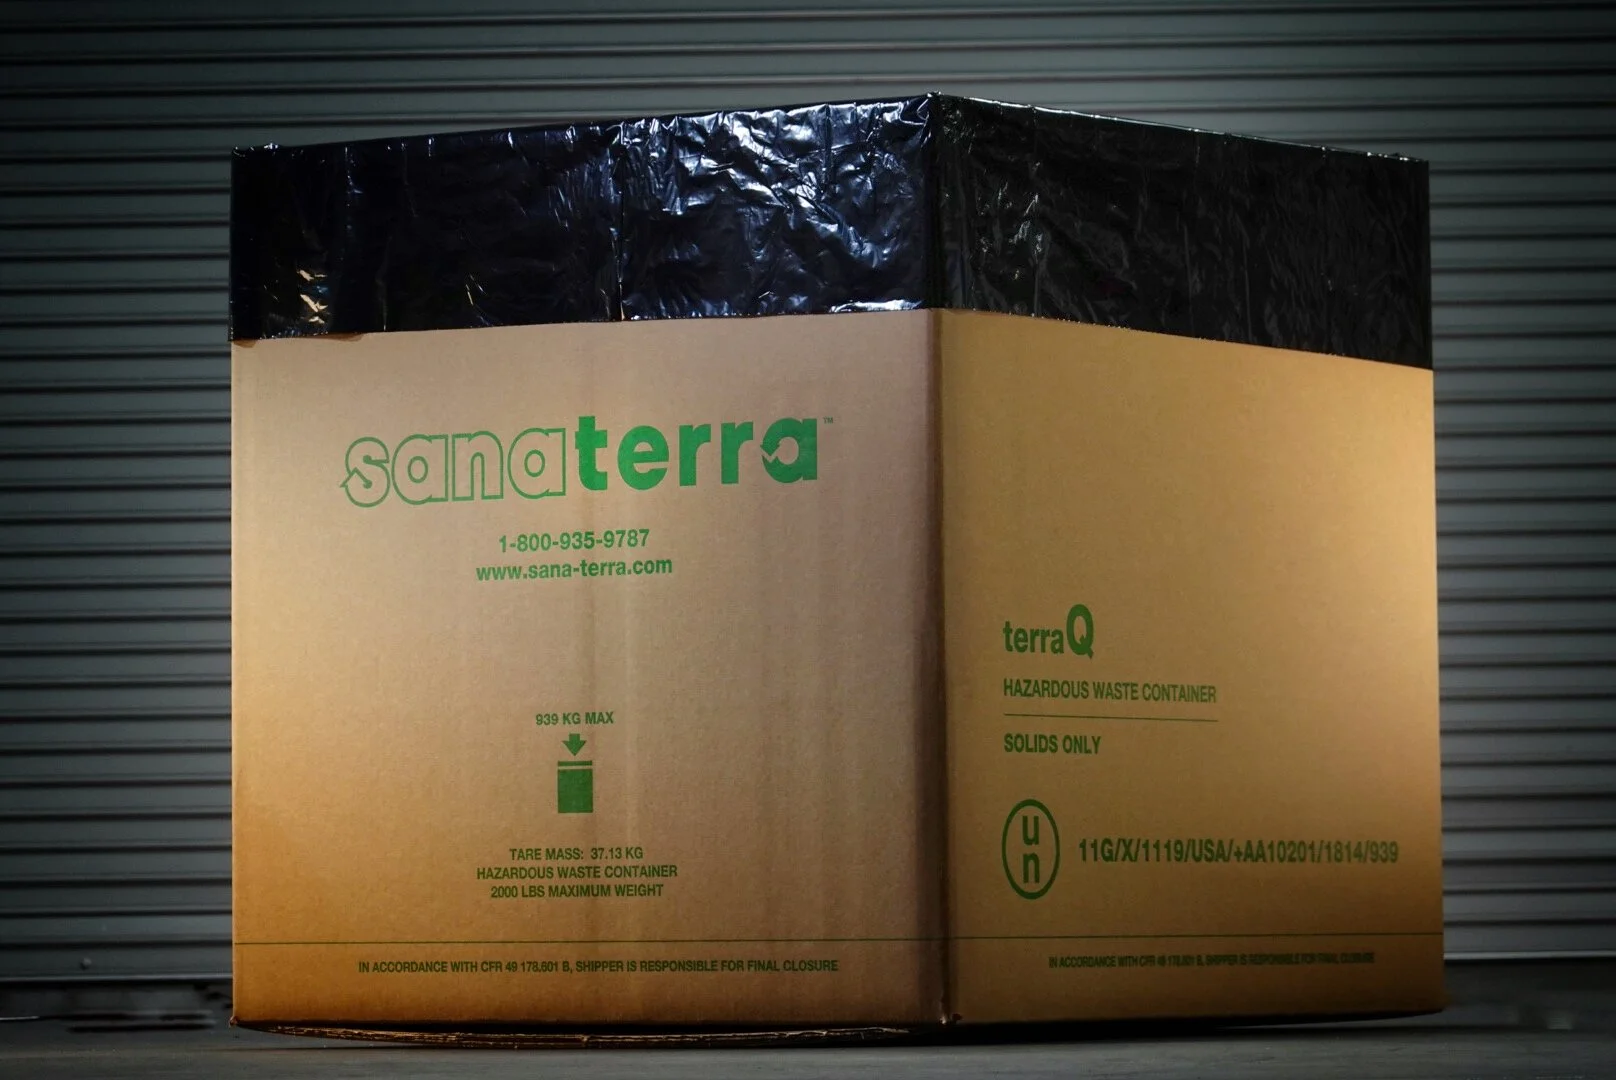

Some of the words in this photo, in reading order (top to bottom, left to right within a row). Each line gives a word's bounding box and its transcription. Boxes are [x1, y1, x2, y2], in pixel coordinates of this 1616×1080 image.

[499, 528, 650, 554] 1-800-935-9787
[476, 558, 673, 581] www.sana-terra.com
[1003, 677, 1089, 699] HAZARDOUS
[1092, 680, 1139, 701] WASTE
[1142, 683, 1217, 703] CONTAINER
[535, 713, 559, 726] 939
[562, 712, 581, 725] KG
[585, 711, 614, 724] MAX
[1003, 733, 1059, 753] SOLIDS
[1062, 735, 1101, 754] ONLY
[509, 848, 542, 860] TARE
[545, 847, 584, 860] MASS:
[590, 847, 622, 860] 37.13
[625, 846, 644, 859] KG
[1079, 837, 1399, 864] 11G/X/1119/USA/+AA10201/1814/939
[476, 866, 554, 880] HAZARDOUS
[557, 865, 601, 879] WASTE
[604, 864, 678, 878] CONTAINER
[490, 885, 518, 898] 2000
[521, 884, 545, 898] LBS
[548, 884, 611, 897] MAXIMUM
[614, 883, 664, 897] WEIGHT
[358, 961, 370, 973] IN
[372, 961, 448, 973] ACCORDANCE
[450, 961, 478, 973] WITH
[480, 961, 502, 973] CFR
[505, 961, 518, 973] 49
[575, 960, 624, 973] SHIPPER
[627, 960, 637, 972] IS
[640, 960, 718, 972] RESPONSIBLE
[721, 960, 744, 972] FOR
[747, 960, 780, 972] FINAL
[783, 959, 839, 972] CLOSURE
[1059, 955, 1116, 968] ACCORDANCE
[1117, 955, 1138, 967] WITH
